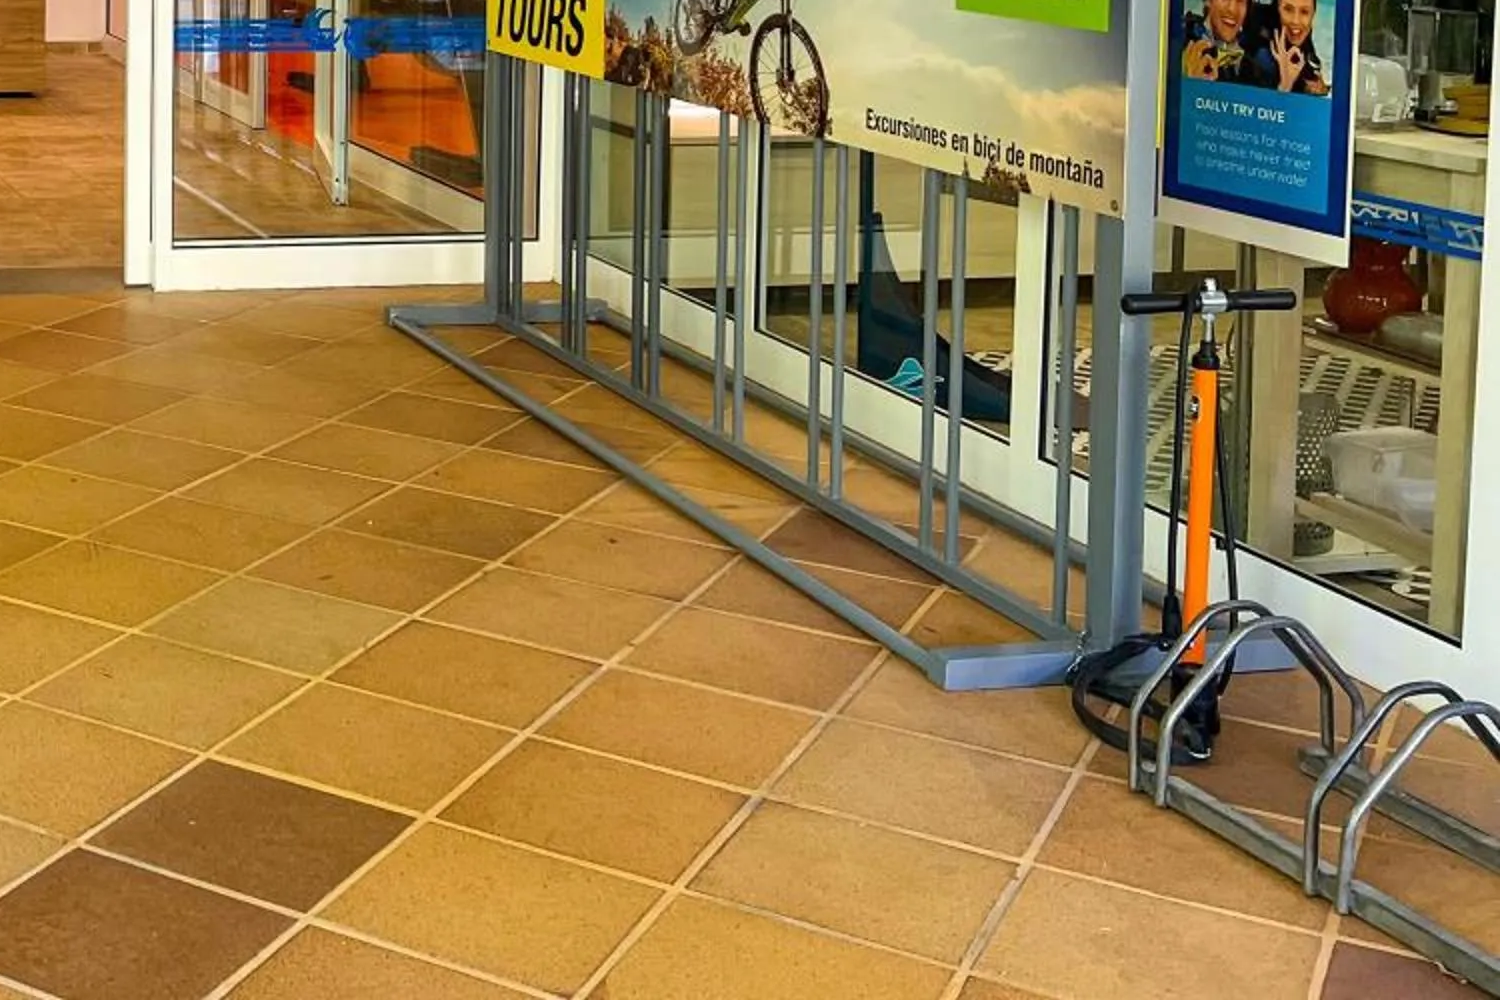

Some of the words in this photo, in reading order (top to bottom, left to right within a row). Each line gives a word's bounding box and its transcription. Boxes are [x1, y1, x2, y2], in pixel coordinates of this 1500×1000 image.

[1195, 97, 1229, 112] DAILY
[1233, 103, 1255, 117] TRY
[1257, 107, 1285, 123] DIVE
[866, 108, 947, 148] Excursiones
[951, 133, 969, 153] en
[974, 133, 1001, 163] bici
[1006, 141, 1025, 168] de
[1029, 152, 1104, 189] montaña
